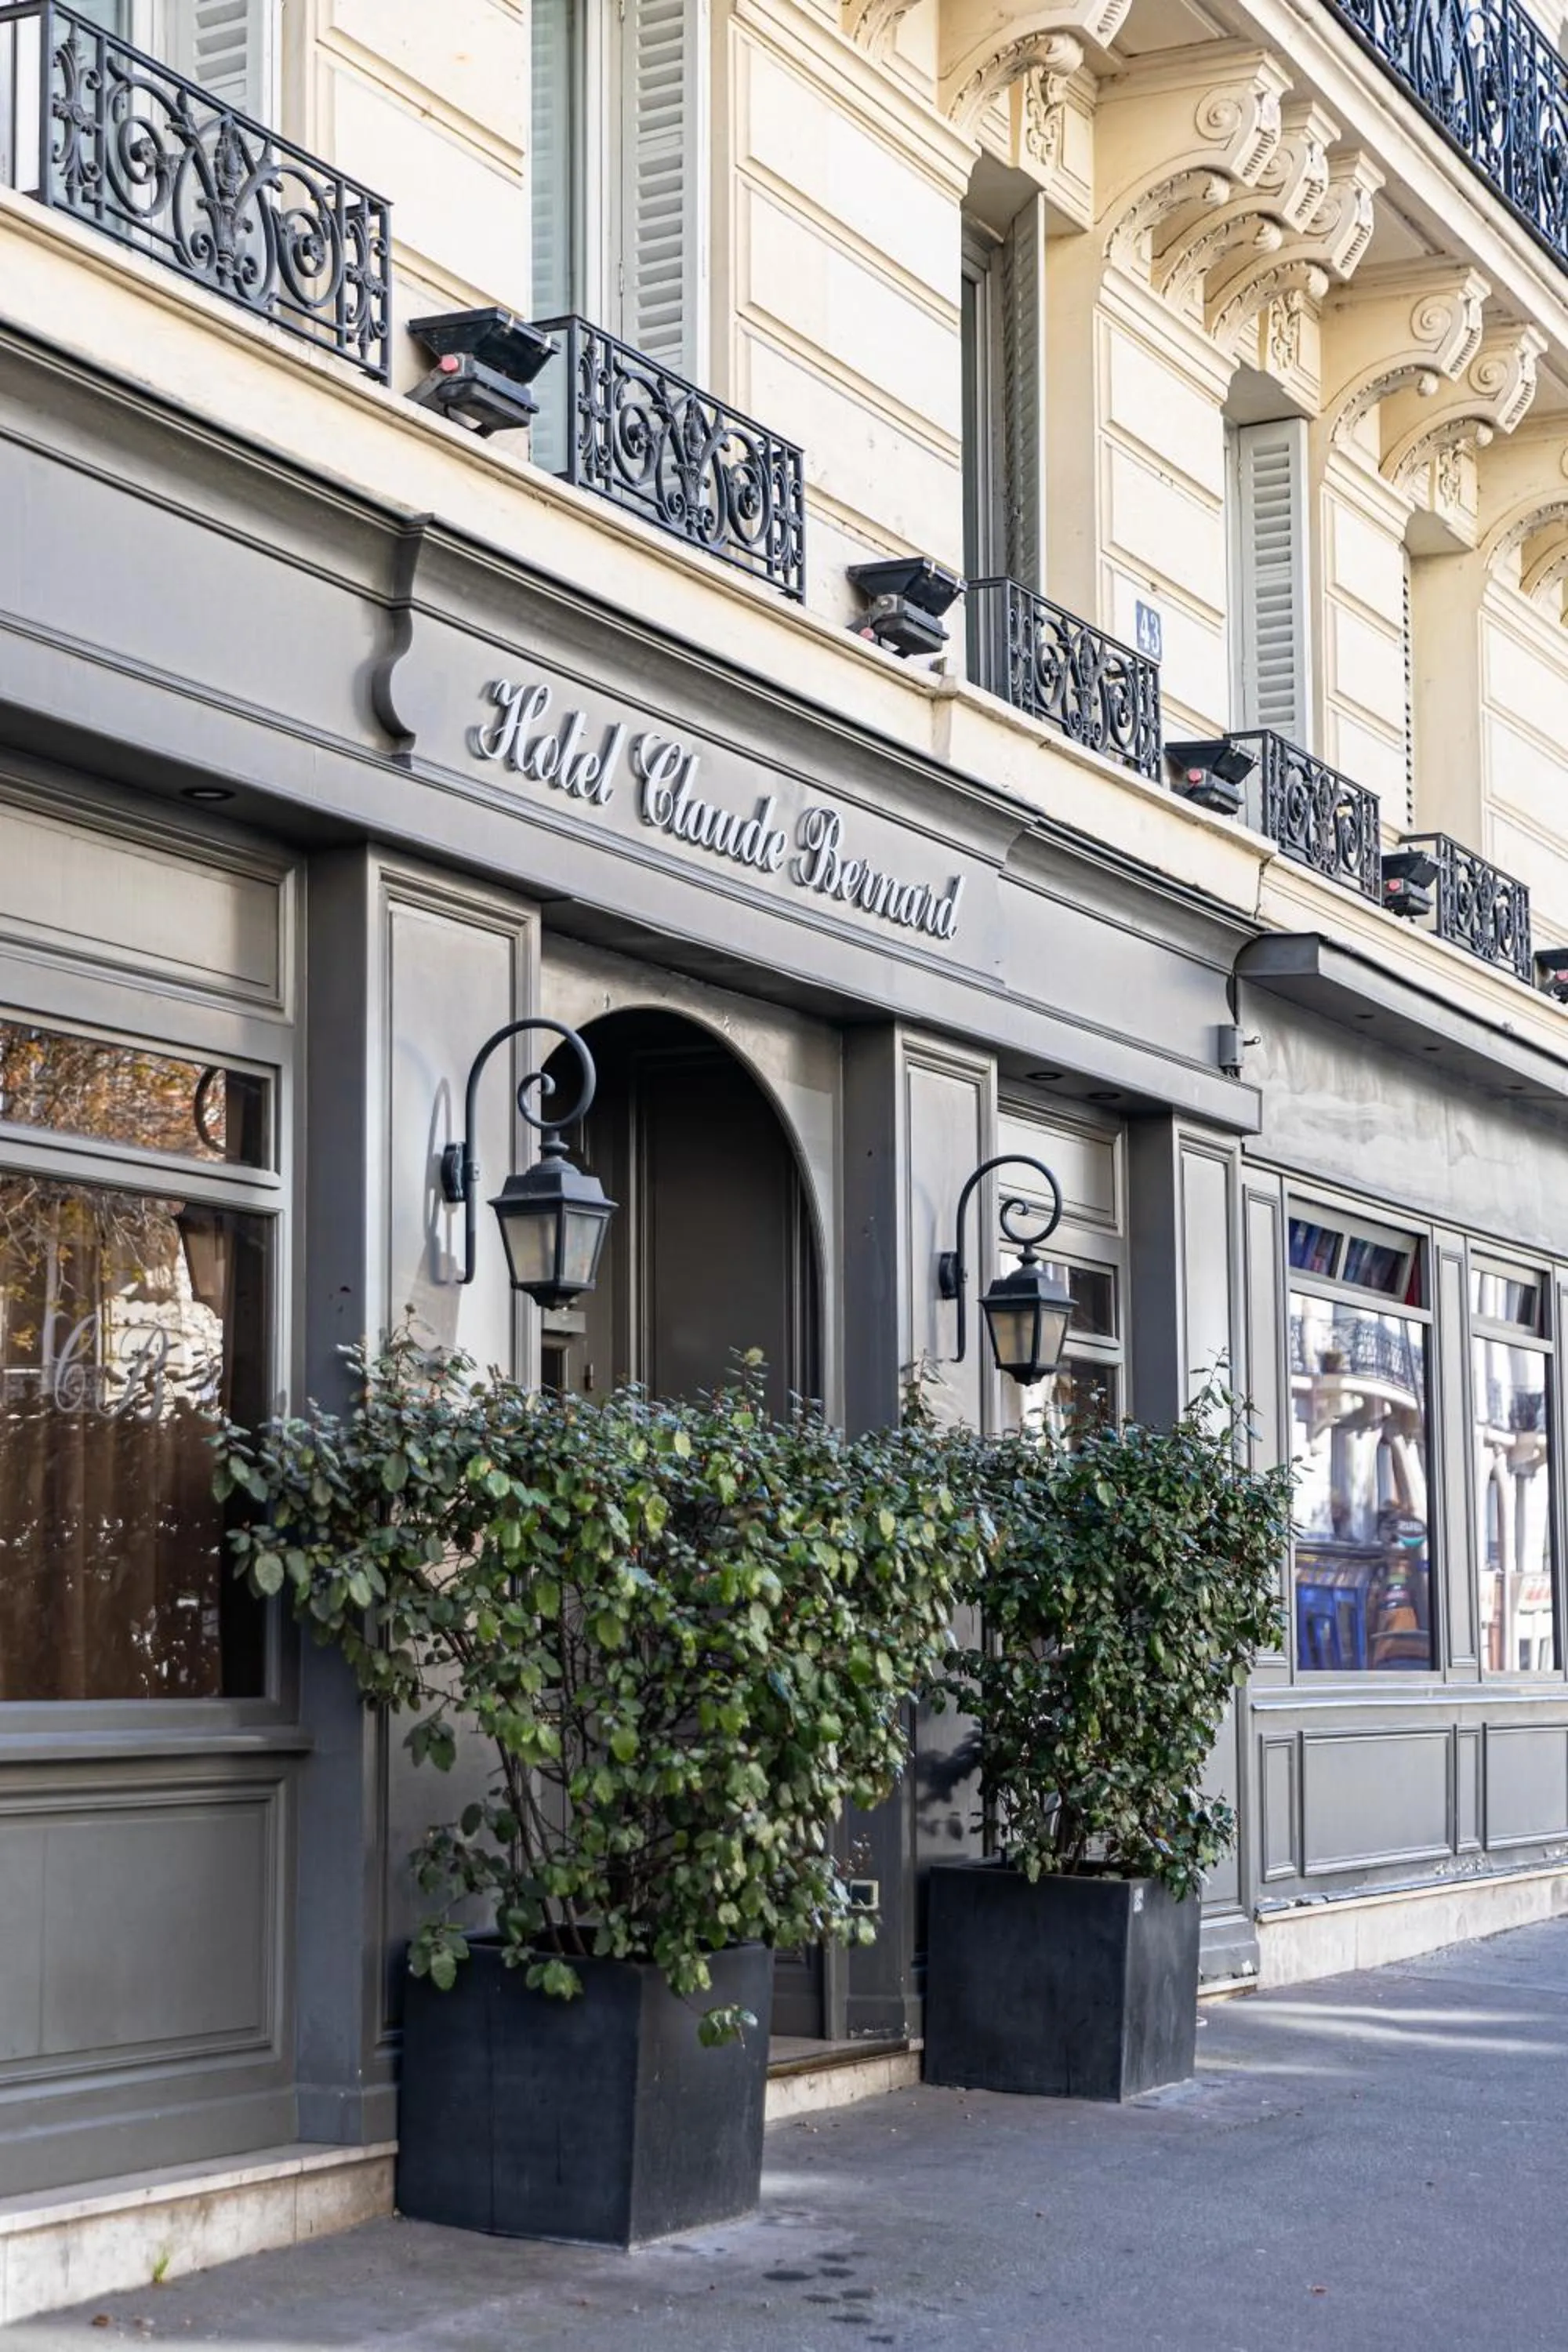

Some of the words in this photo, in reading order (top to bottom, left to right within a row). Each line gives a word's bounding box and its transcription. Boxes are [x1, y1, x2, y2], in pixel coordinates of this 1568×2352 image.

[1139, 608, 1160, 653] 43
[473, 679, 627, 805] Hotel
[633, 732, 788, 872] Claude
[793, 807, 966, 939] Bernard
